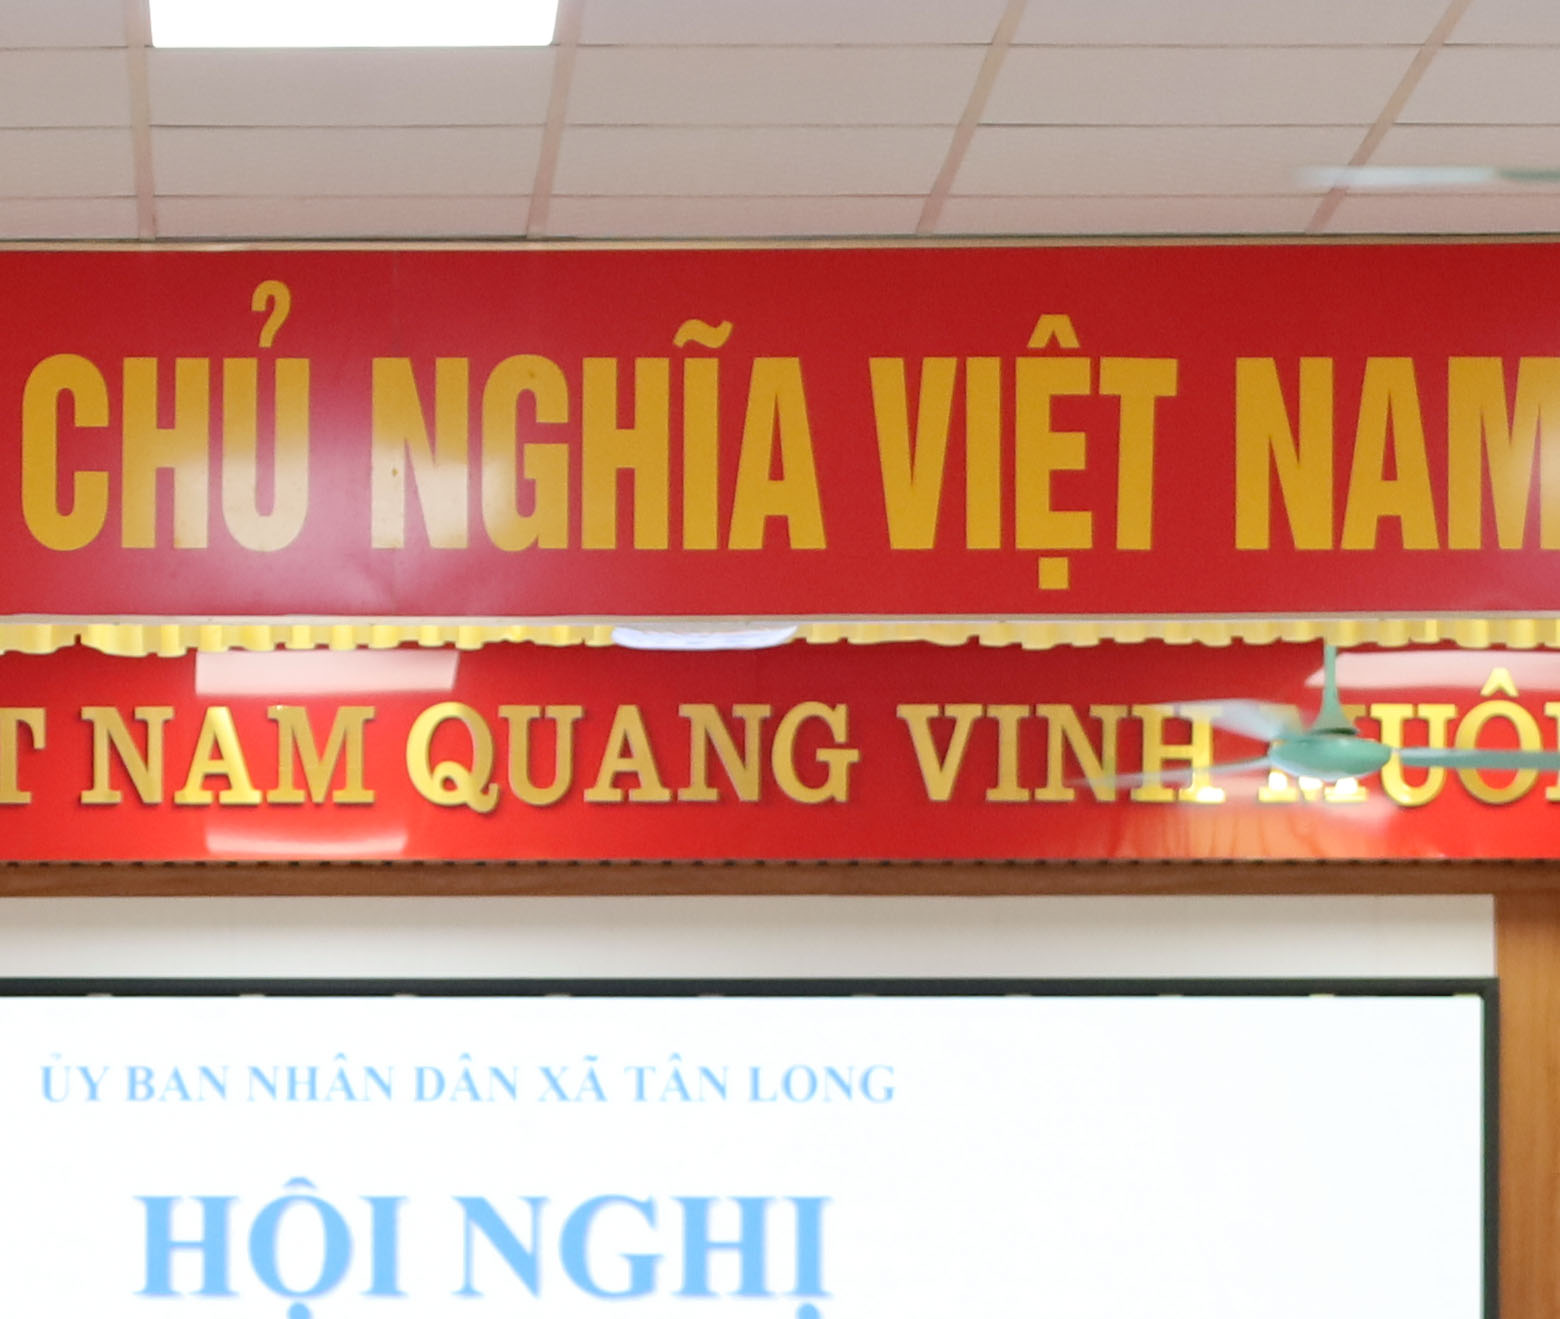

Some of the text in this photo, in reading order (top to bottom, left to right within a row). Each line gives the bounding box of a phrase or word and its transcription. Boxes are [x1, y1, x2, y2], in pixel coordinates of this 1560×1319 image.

[24, 282, 308, 550] CHỦ
[374, 320, 826, 550] NGHĨA
[872, 315, 1177, 589] VIỆT
[80, 706, 376, 805] NAM
[406, 701, 860, 812] QUANG
[899, 704, 1227, 805] VINH
[125, 1066, 229, 1101] BAN
[250, 1053, 392, 1101] NHÂN
[416, 1053, 516, 1101] DÂN
[540, 1055, 607, 1102] XÃ
[625, 1053, 726, 1101] TÂN
[750, 1066, 894, 1101] LONG
